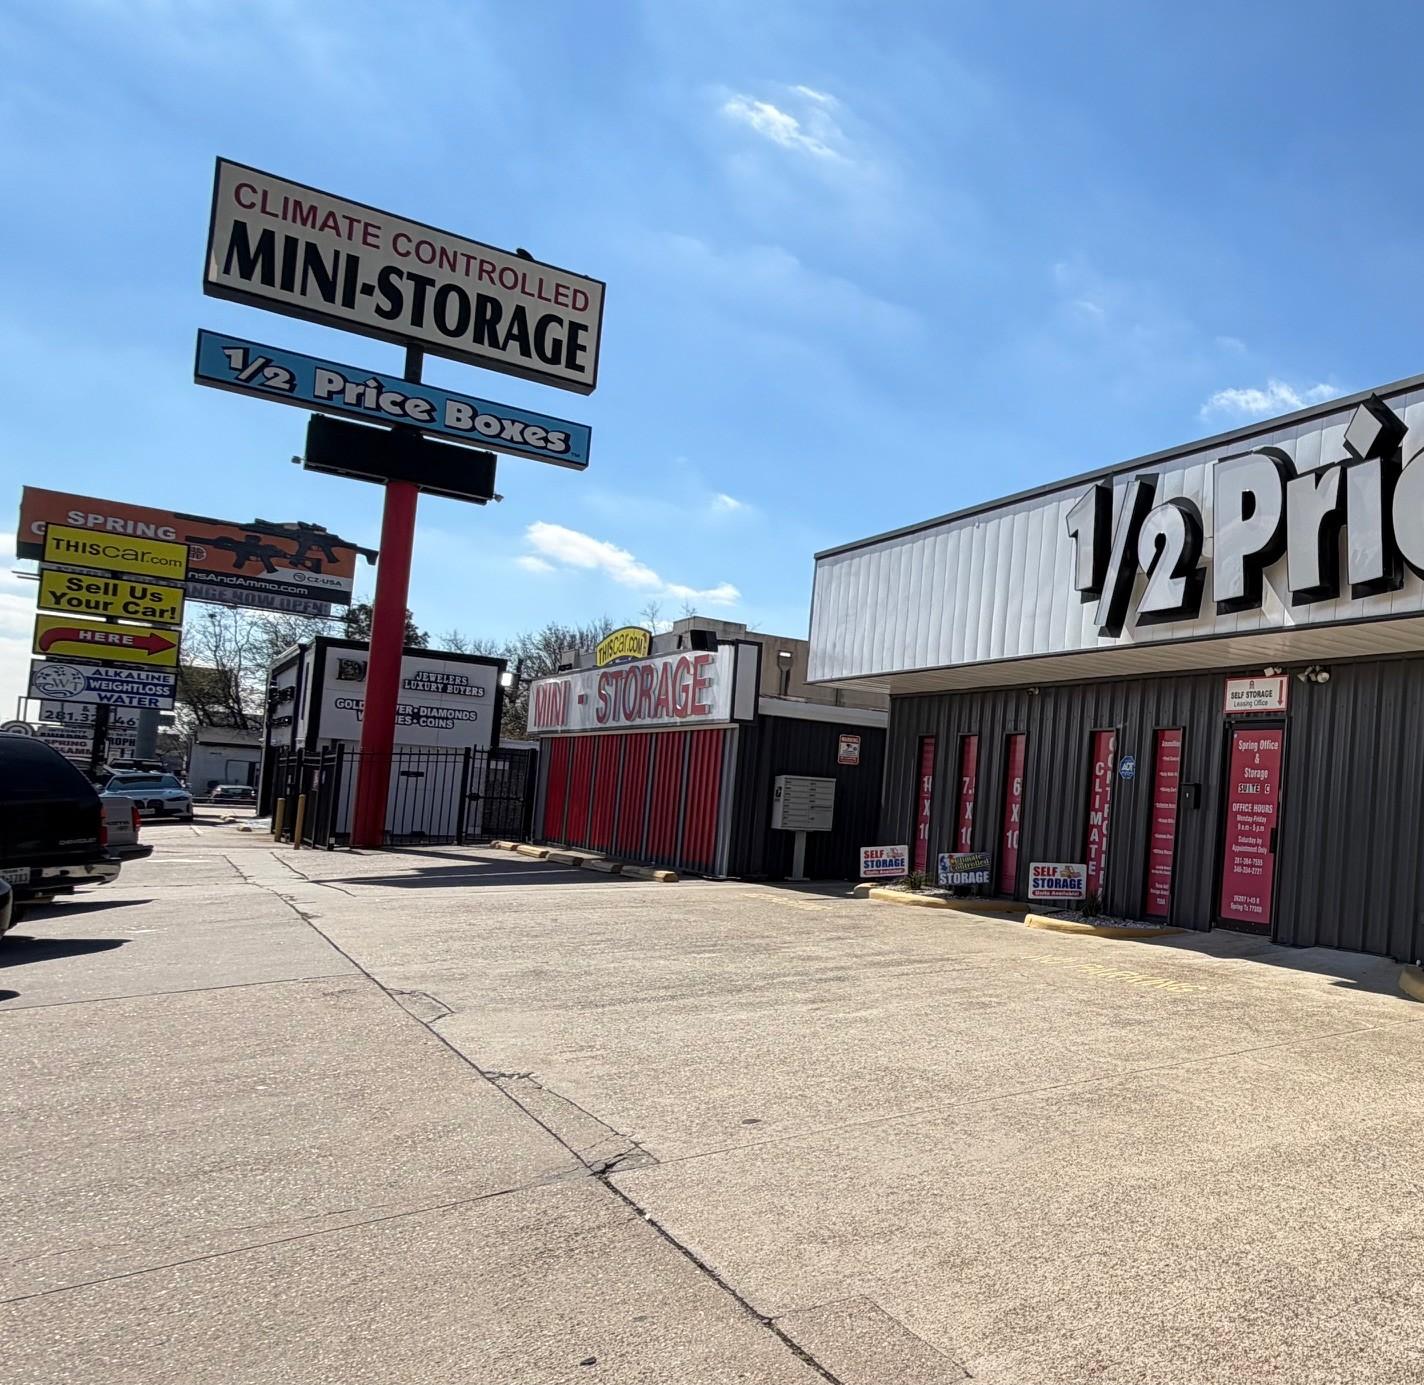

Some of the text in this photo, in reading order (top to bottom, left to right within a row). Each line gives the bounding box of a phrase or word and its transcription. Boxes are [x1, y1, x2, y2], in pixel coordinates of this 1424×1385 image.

[234, 183, 589, 312] CLIMATE CONTROLLED
[223, 219, 588, 373] MINI-STORAGE
[314, 367, 436, 422] Price
[444, 399, 571, 454] Boxes
[67, 511, 176, 540] SPRING
[188, 571, 308, 595] nsAndAmmo.com
[307, 575, 343, 588] CZ-USA
[66, 577, 118, 597] Sell
[129, 586, 163, 602] Us
[48, 590, 177, 620] Your Car!
[79, 630, 134, 645] HERE
[91, 668, 171, 684] ALKALINE
[416, 671, 468, 686] JEWELERS
[89, 680, 170, 696] WEIGHTLOSS
[404, 680, 485, 697] LUXURY BUYERS
[534, 681, 571, 727] MINI
[596, 654, 715, 724] STORAGE
[1231, 689, 1273, 699] SELF STORAGE
[97, 692, 160, 708] WATER
[1234, 700, 1252, 708] Leasing
[335, 699, 365, 710] GOLD
[419, 707, 477, 721] DIAMONDS
[420, 719, 454, 730] COINS
[1239, 740, 1278, 751] Spring Office
[1254, 753, 1260, 764] &
[1121, 762, 1134, 771] ADT
[1244, 768, 1268, 780] Storage
[963, 777, 975, 794] 7.
[1233, 803, 1272, 813] OFFICE HOURS
[1088, 762, 1105, 875] CLIMATE
[864, 850, 884, 859] SELF
[864, 858, 905, 868] STORAGE
[940, 871, 990, 885] STORAGE
[1033, 866, 1058, 877] SELF
[1032, 878, 1082, 889] STORAGE
